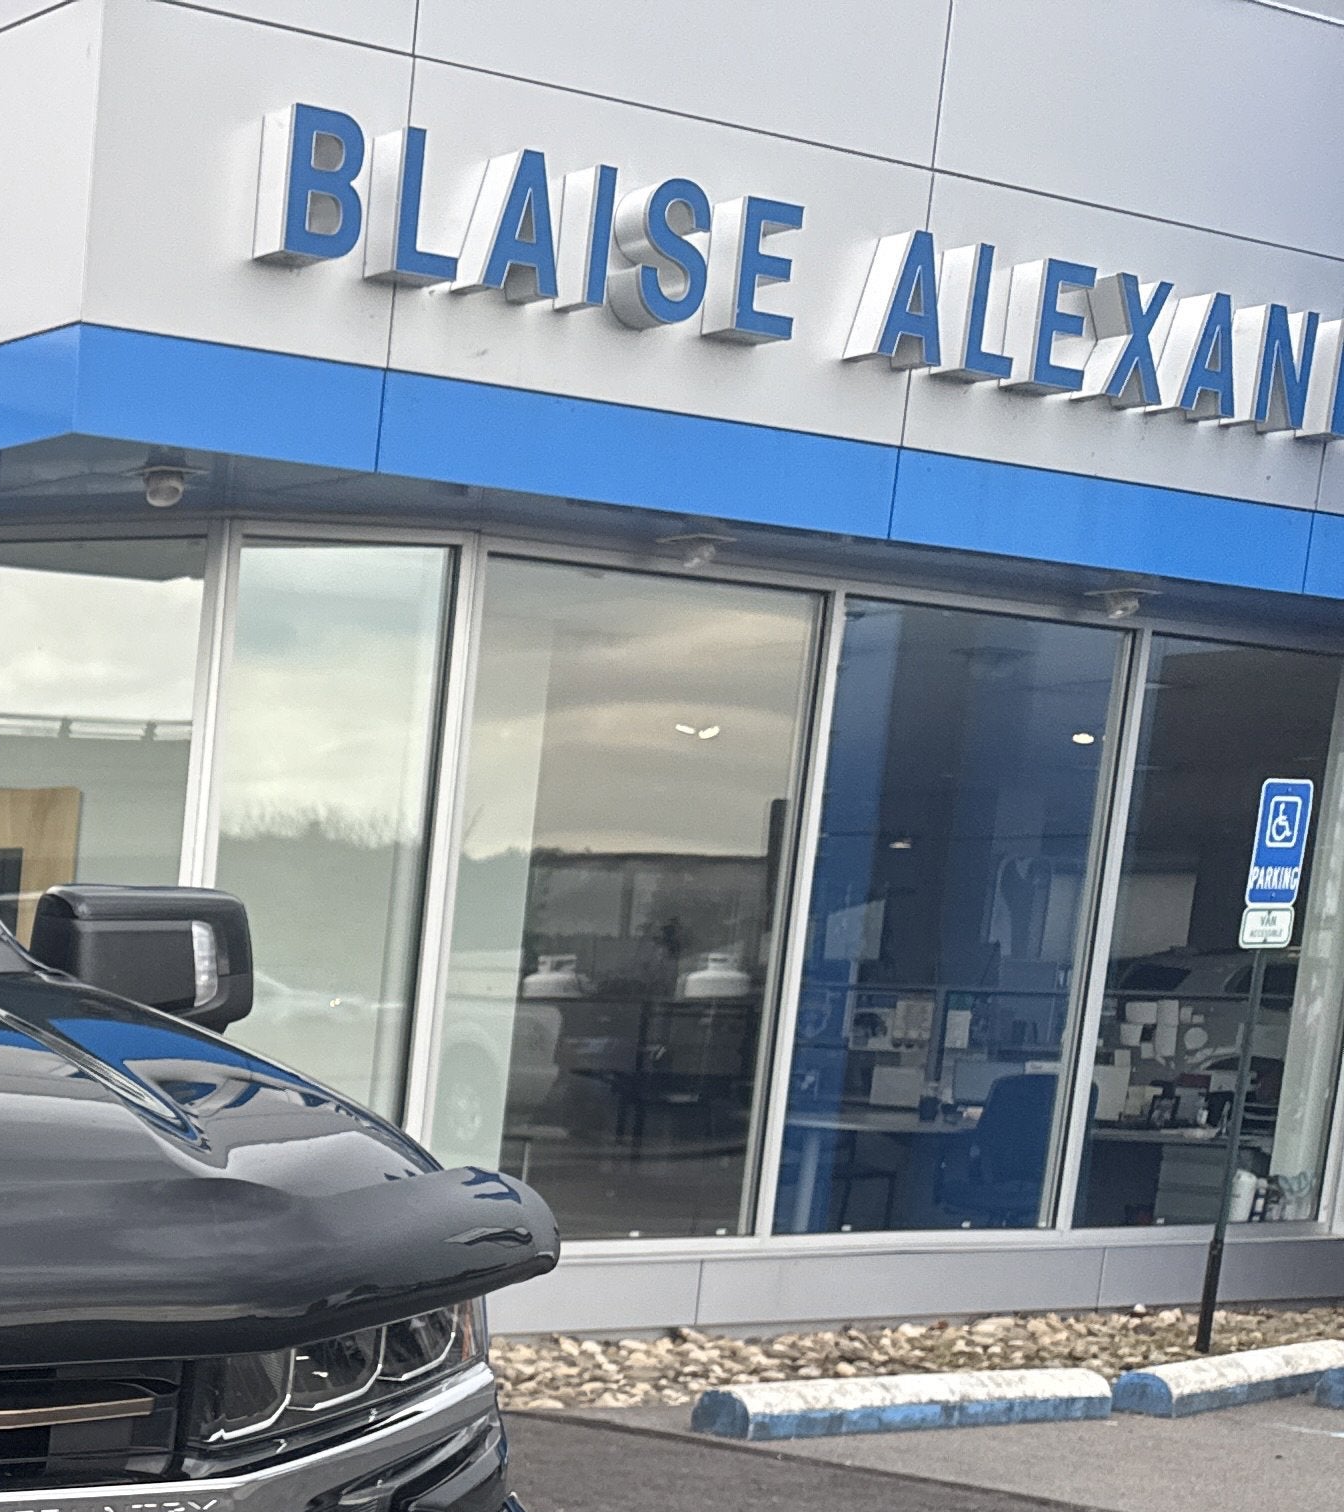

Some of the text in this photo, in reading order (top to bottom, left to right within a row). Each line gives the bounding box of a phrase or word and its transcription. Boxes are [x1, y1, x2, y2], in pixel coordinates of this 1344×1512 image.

[278, 102, 1344, 439] BLAISE ALEXAN
[1247, 866, 1299, 891] PARKING
[1260, 915, 1278, 926] VAN
